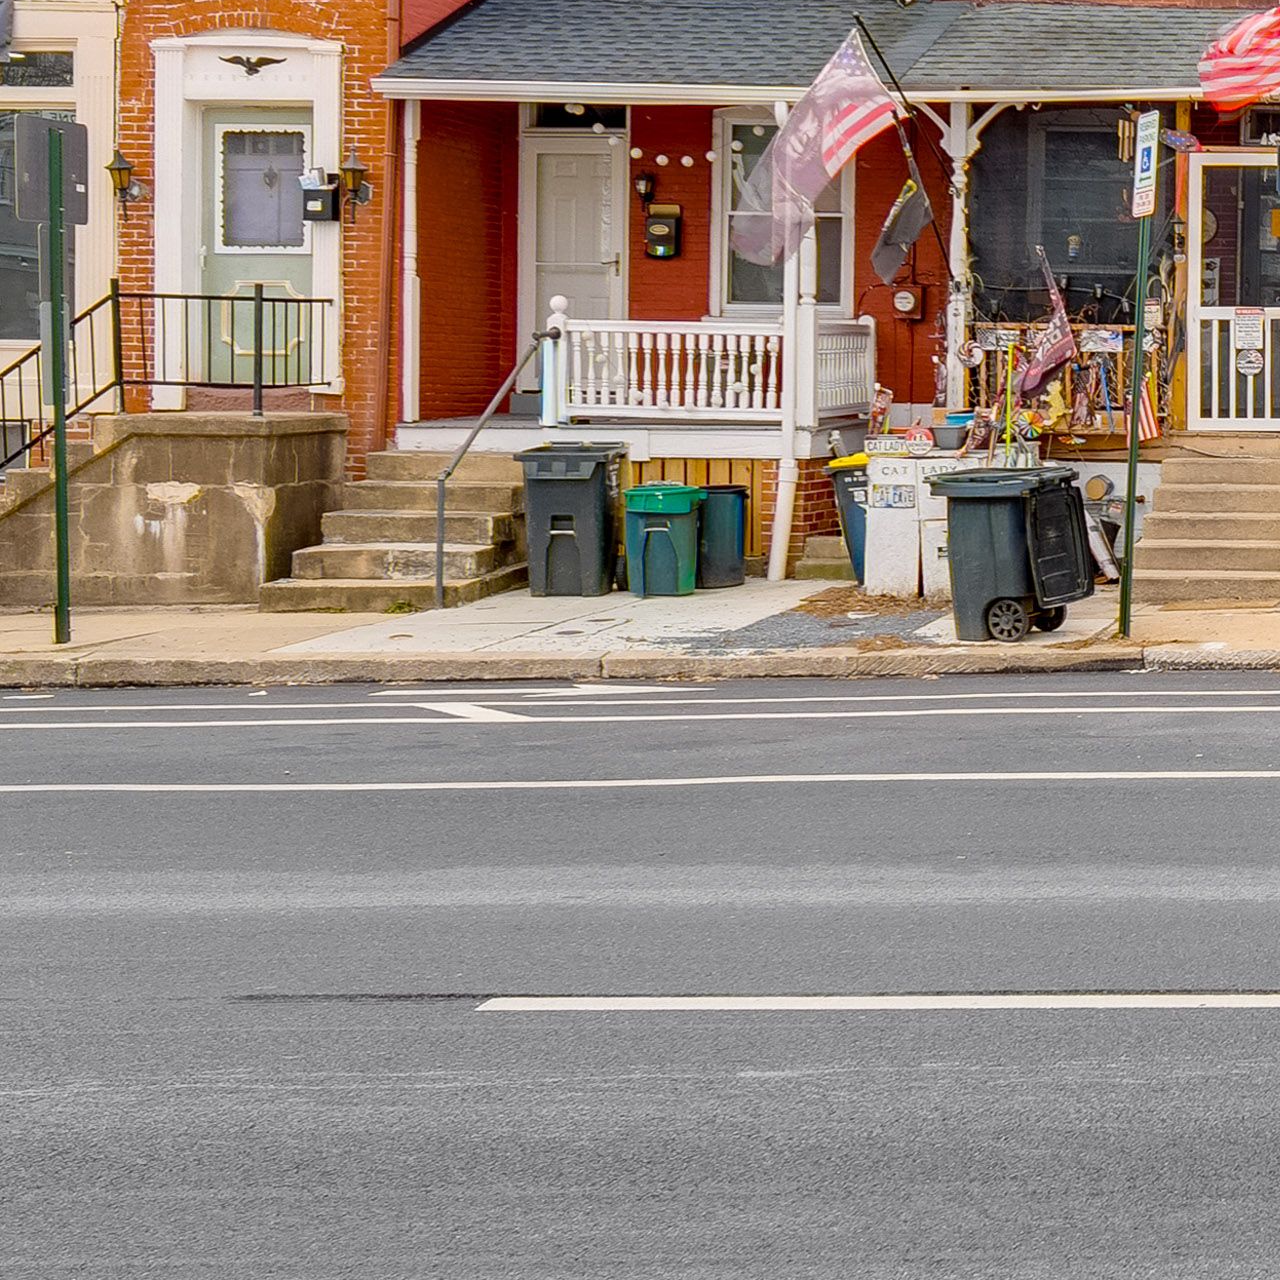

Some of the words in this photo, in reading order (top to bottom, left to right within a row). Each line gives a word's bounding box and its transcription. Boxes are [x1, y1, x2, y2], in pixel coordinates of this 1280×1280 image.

[867, 441, 883, 451] CAT
[884, 441, 904, 451] LADY
[881, 466, 908, 475] CAT
[921, 465, 957, 475] LADY
